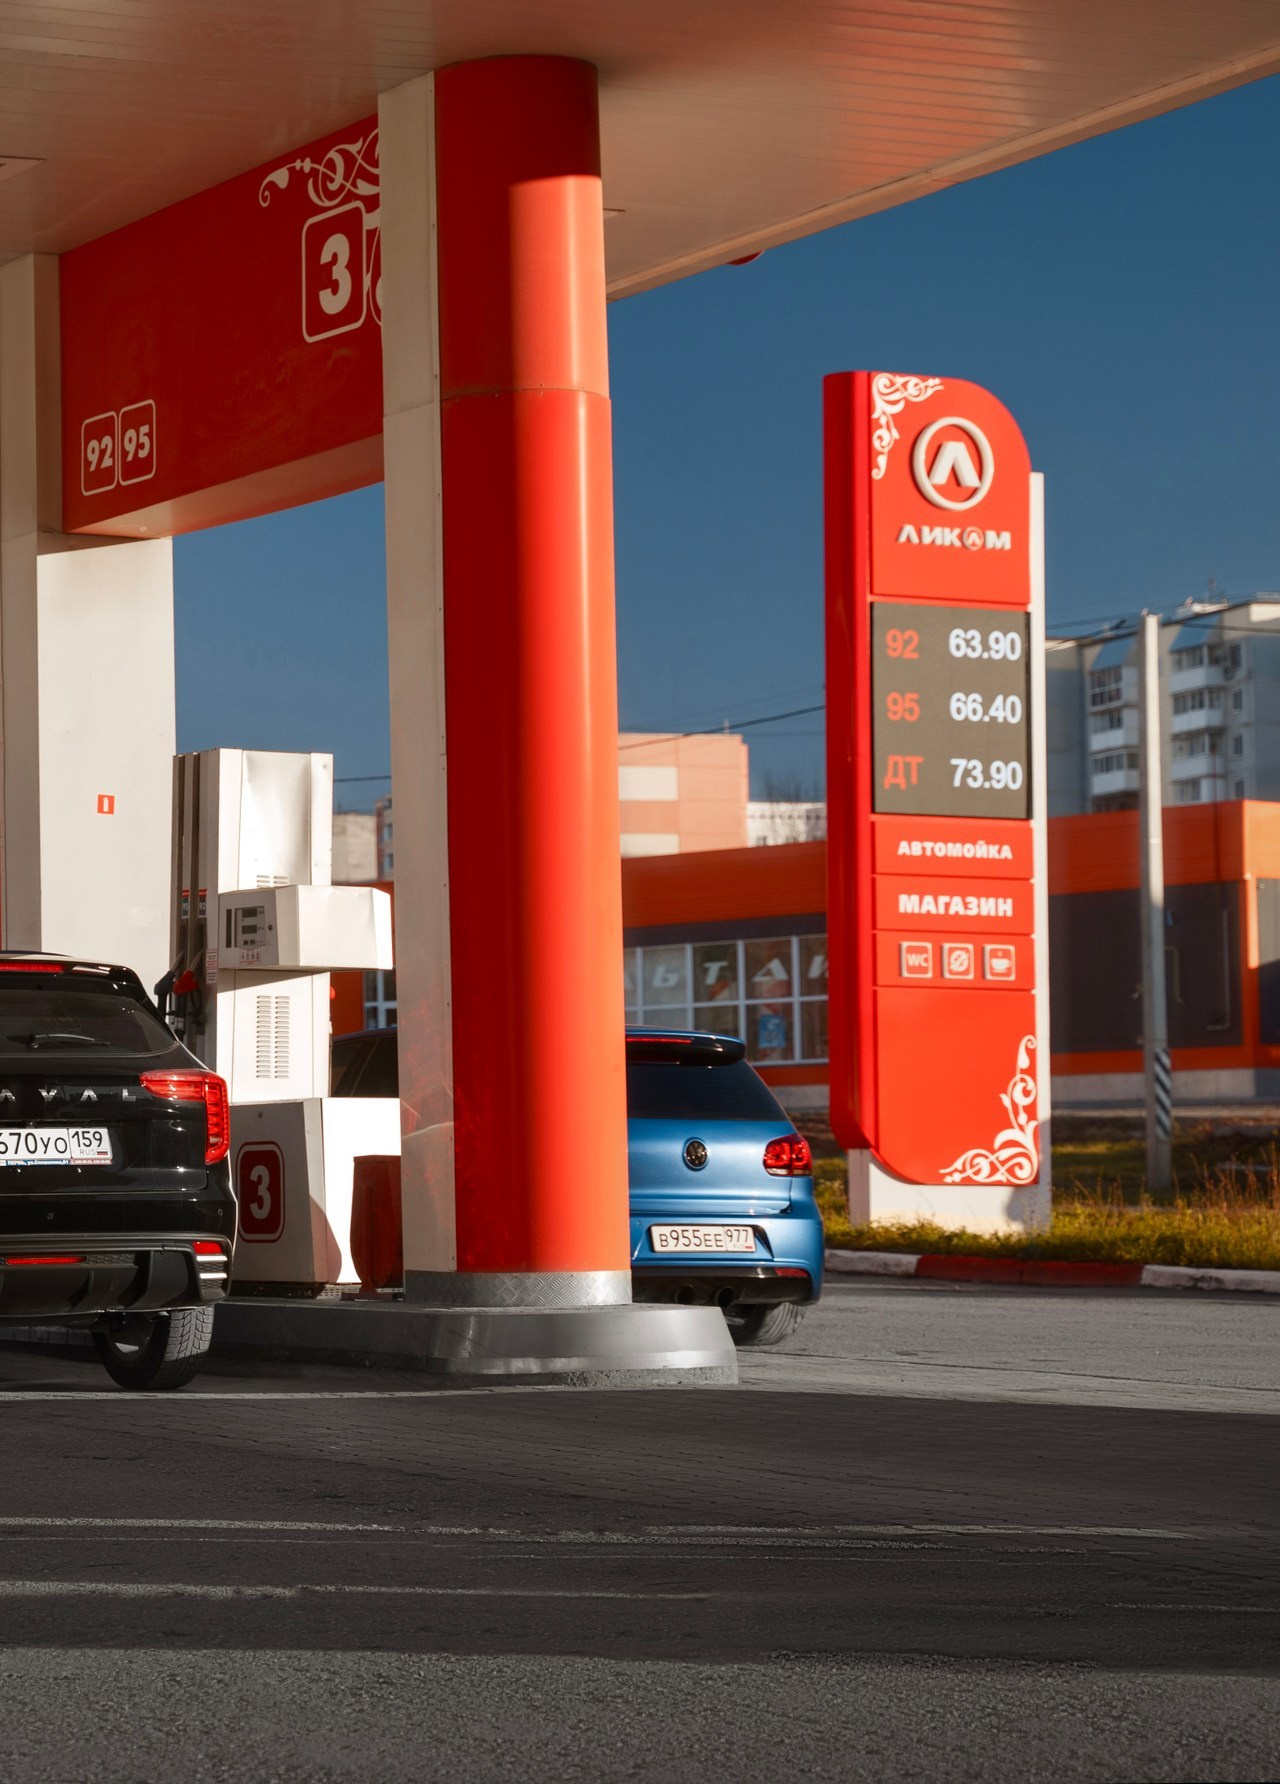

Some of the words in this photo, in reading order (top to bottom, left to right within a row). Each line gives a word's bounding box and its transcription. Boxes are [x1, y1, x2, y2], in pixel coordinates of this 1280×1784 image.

[318, 233, 352, 315] 3
[86, 435, 113, 473] 92
[123, 424, 150, 462] 95
[885, 628, 919, 659] 92
[948, 628, 1022, 661] 63.90
[885, 691, 920, 722] 95
[949, 691, 1022, 724] 66.40
[883, 754, 925, 791] ДТ
[950, 758, 1023, 790] 73.90
[897, 839, 1013, 860] АВТОМОЙКА
[898, 893, 1013, 917] МАГАЗИН
[906, 953, 929, 967] WC
[71, 1130, 103, 1148] 159
[249, 1165, 272, 1219] 3
[658, 1229, 724, 1248] В955ЕЕ
[725, 1228, 749, 1243] 977
